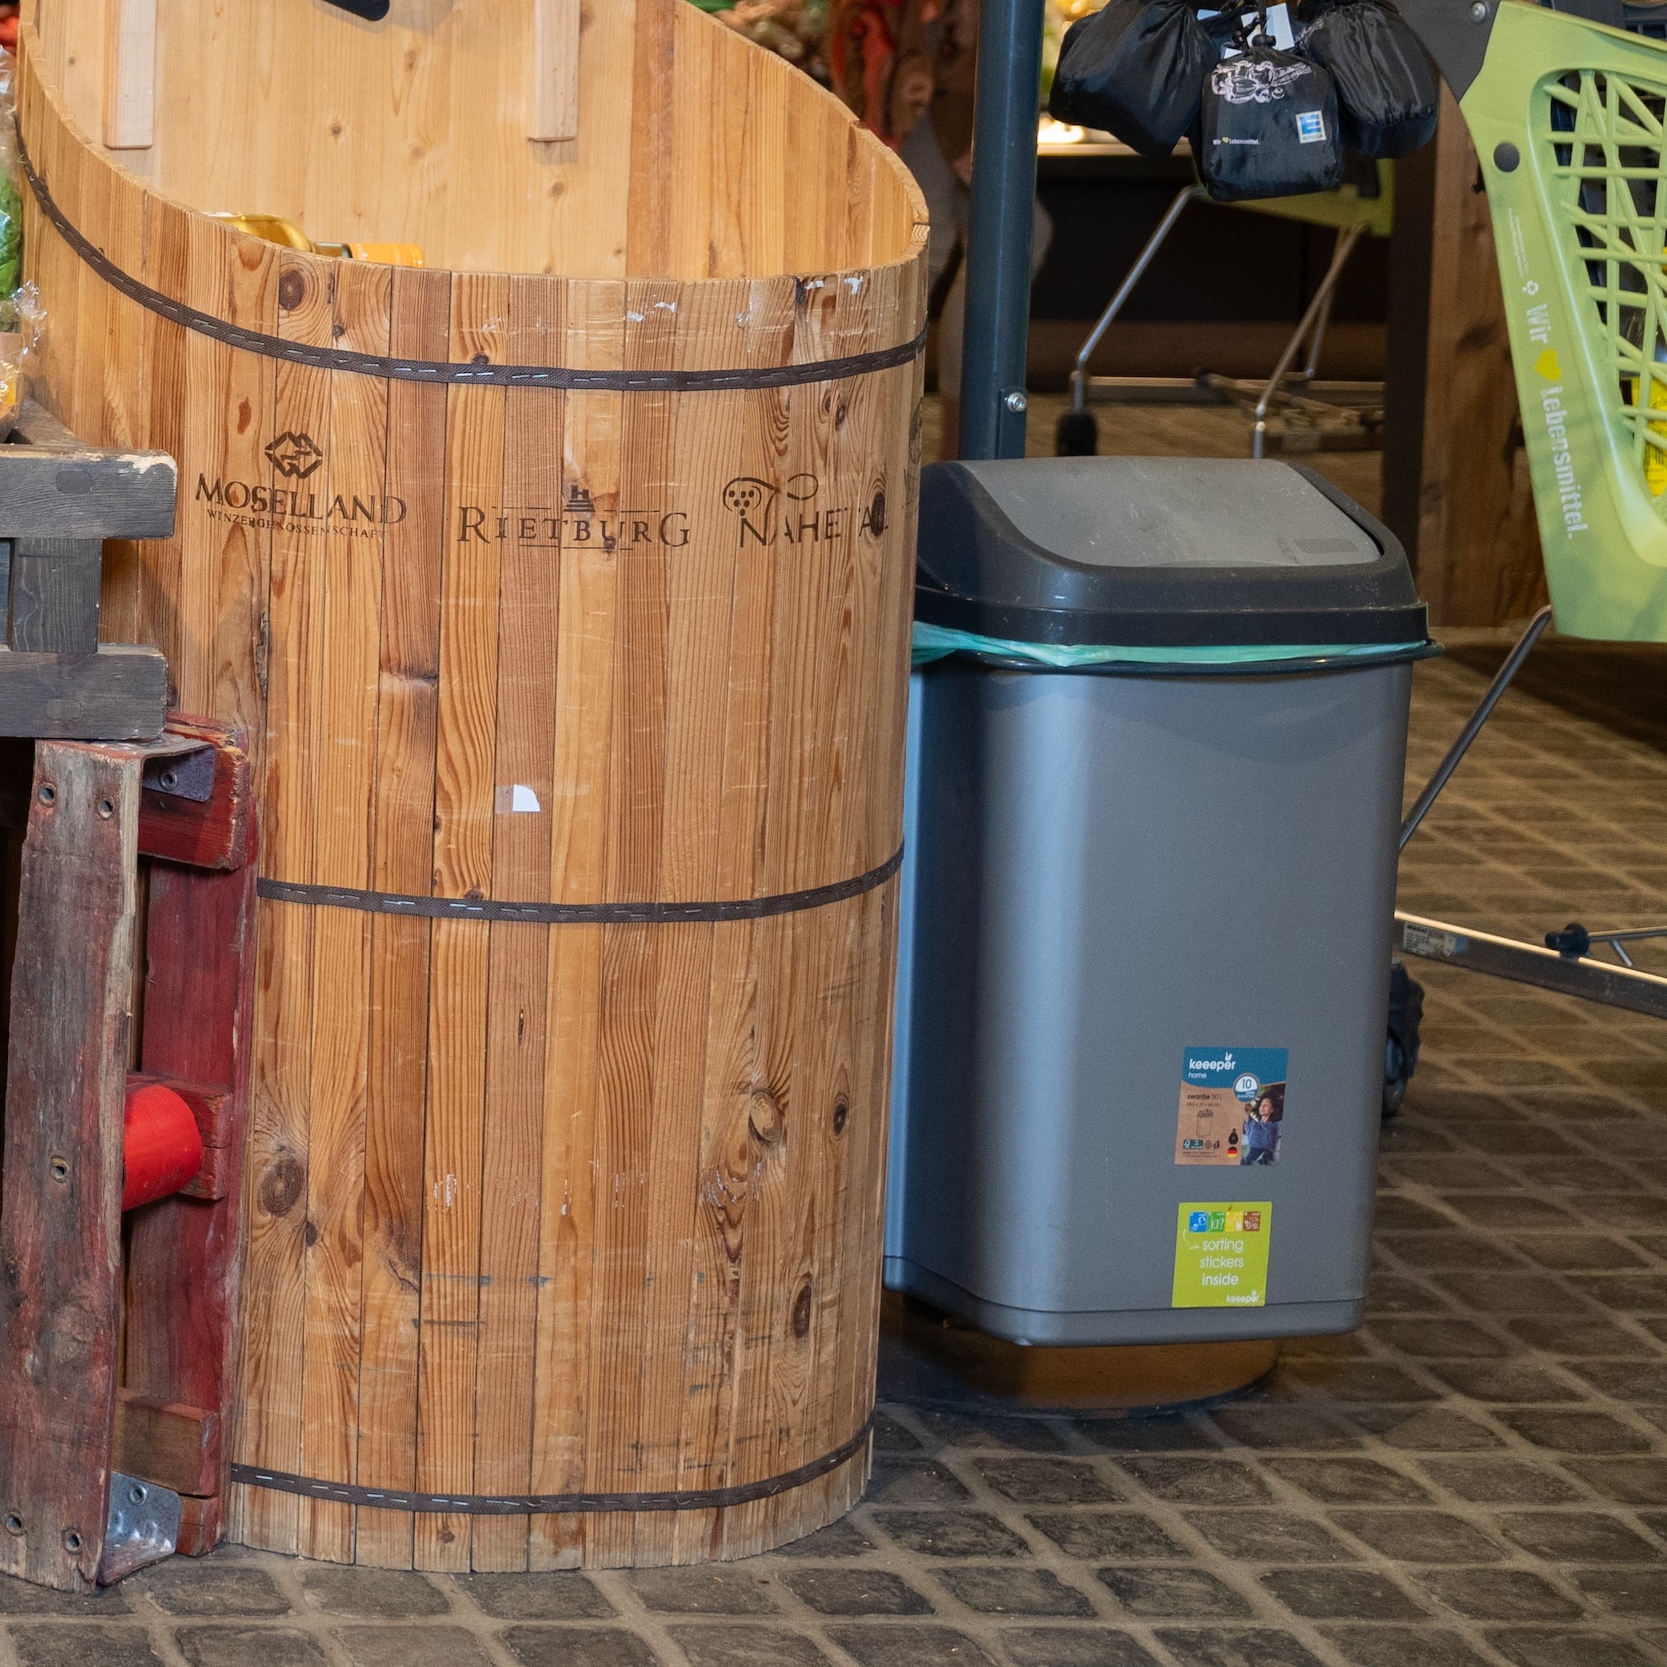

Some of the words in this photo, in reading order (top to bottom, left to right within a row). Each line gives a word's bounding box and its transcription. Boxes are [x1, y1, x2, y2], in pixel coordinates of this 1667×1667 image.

[1524, 303, 1553, 344] Wir
[1540, 386, 1589, 539] Lebensmittel.
[195, 472, 407, 524] MOSELLAND
[207, 508, 387, 539] WINZERGENOSSENSCHAFT
[457, 505, 691, 549] RIETBURG
[1189, 1059, 1236, 1072] keeeper
[1242, 1079, 1251, 1089] 10
[1202, 1238, 1244, 1253] sorting
[1200, 1257, 1244, 1268] stickers
[1202, 1274, 1239, 1285] inside
